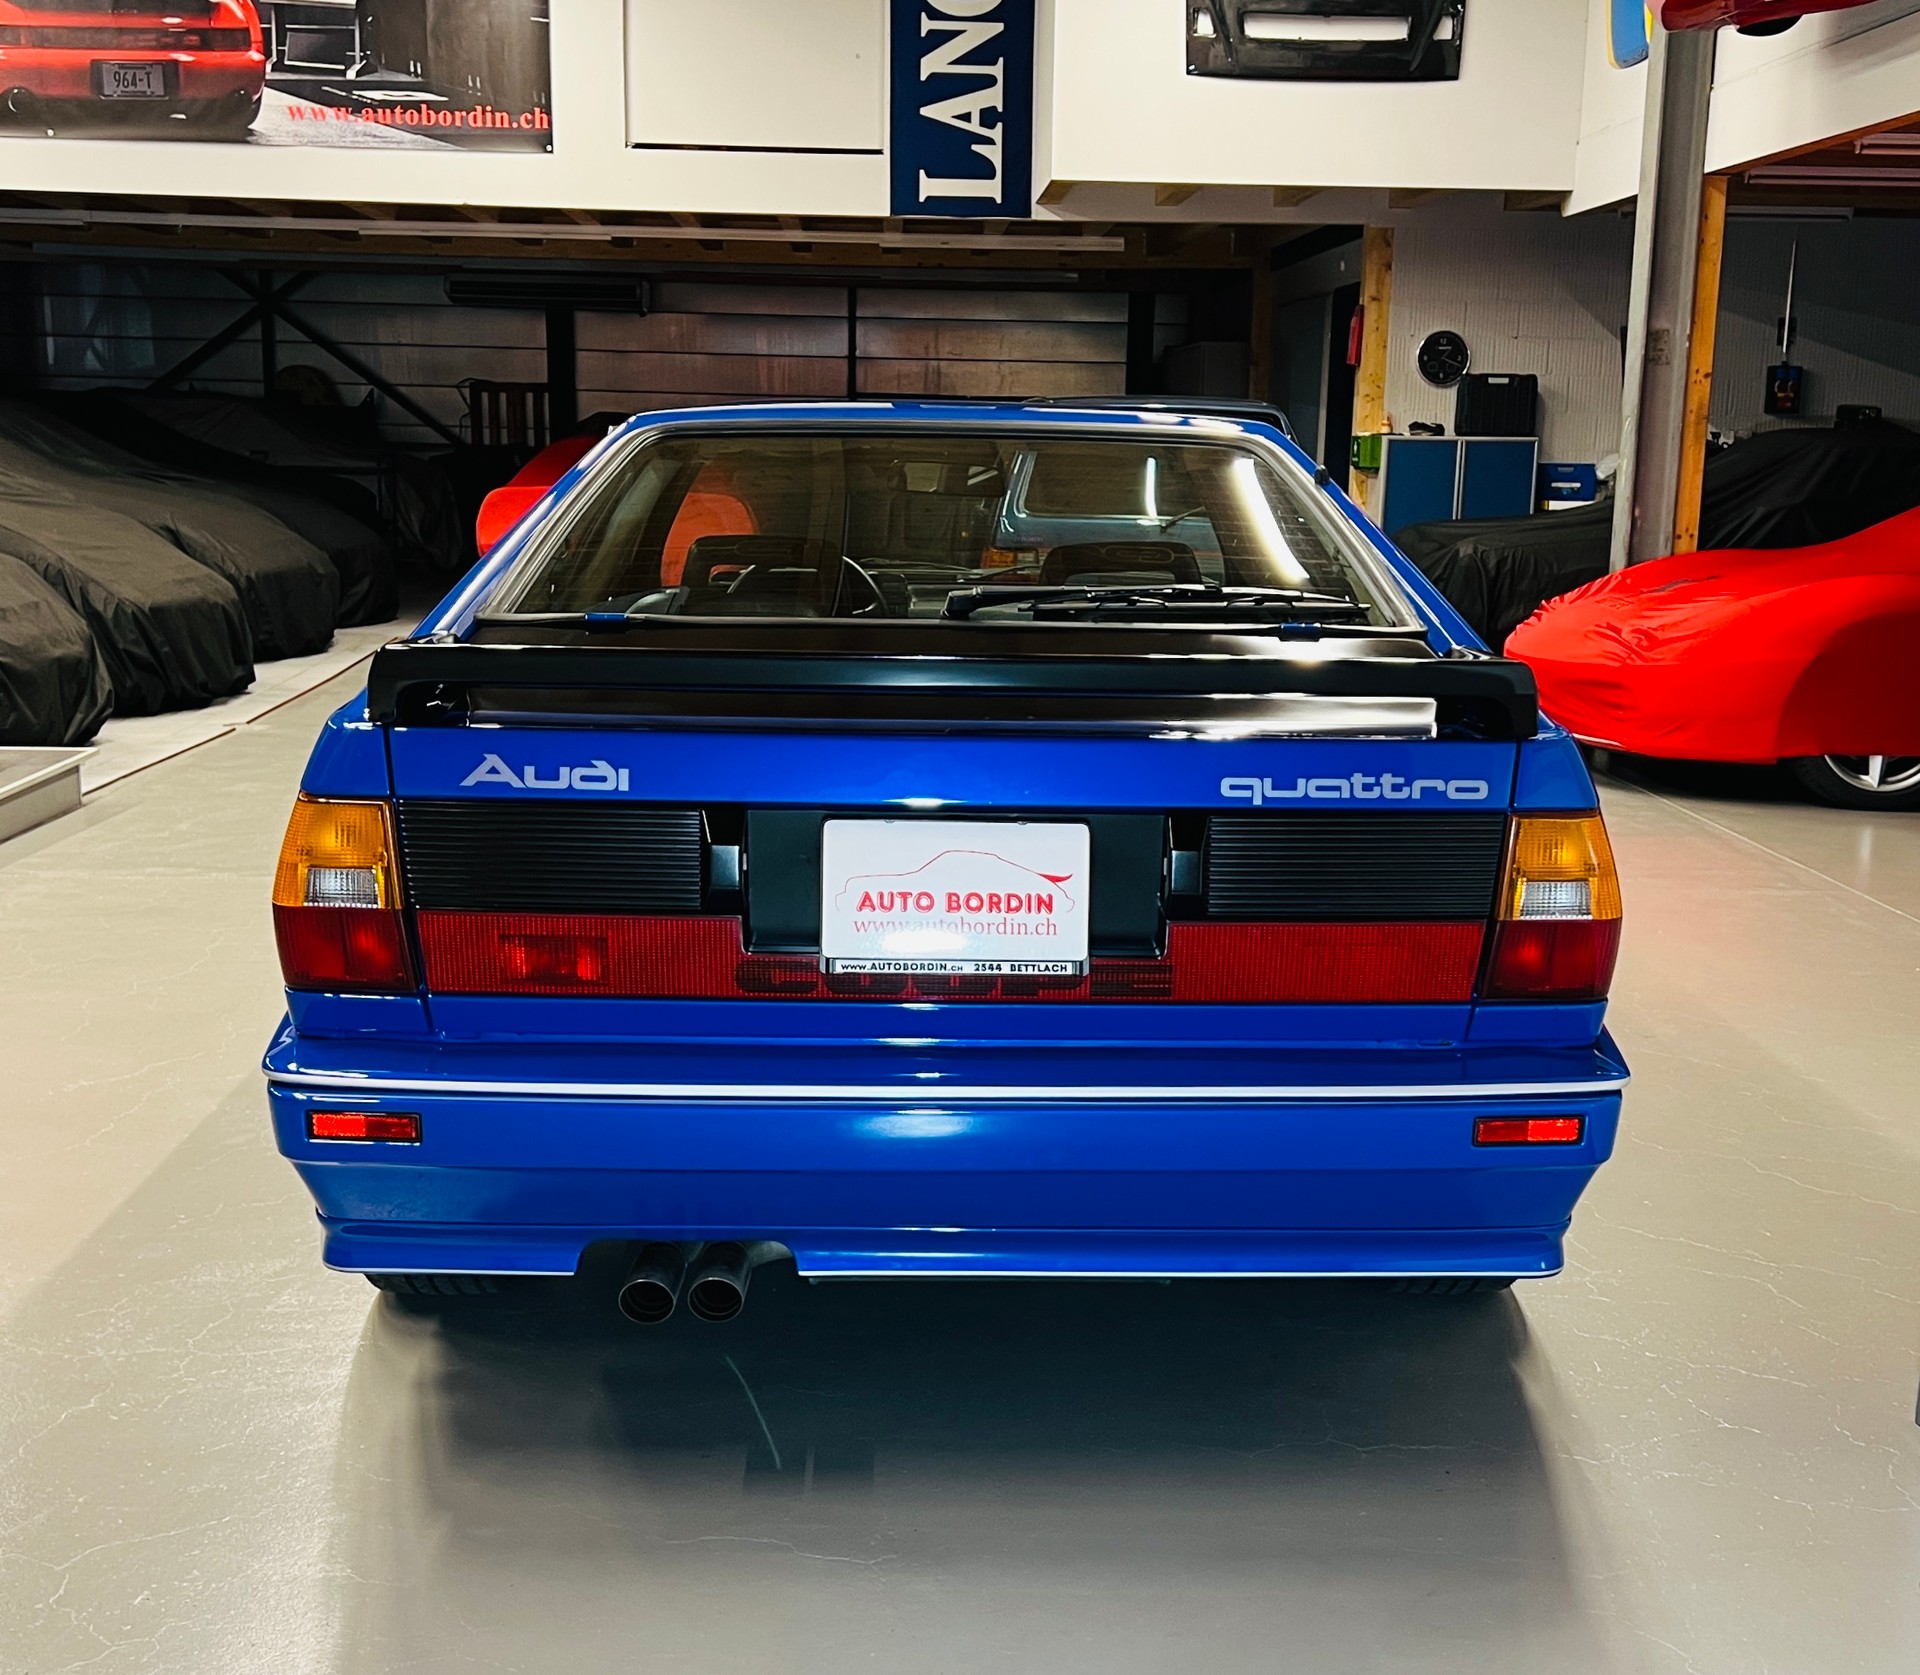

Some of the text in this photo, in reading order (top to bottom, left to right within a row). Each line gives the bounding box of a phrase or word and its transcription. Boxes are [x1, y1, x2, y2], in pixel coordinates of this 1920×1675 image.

[113, 71, 152, 89] 964-T
[919, 0, 1004, 204] LAN
[287, 104, 549, 129] www.autobordin.ch
[459, 753, 629, 791] Audi
[1220, 773, 1489, 805] quattro
[856, 891, 1054, 915] AUTO BORDIN
[854, 917, 1058, 936] wwwautobordin.ch
[974, 964, 1002, 972] 2544
[1009, 964, 1068, 973] BETTLACH
